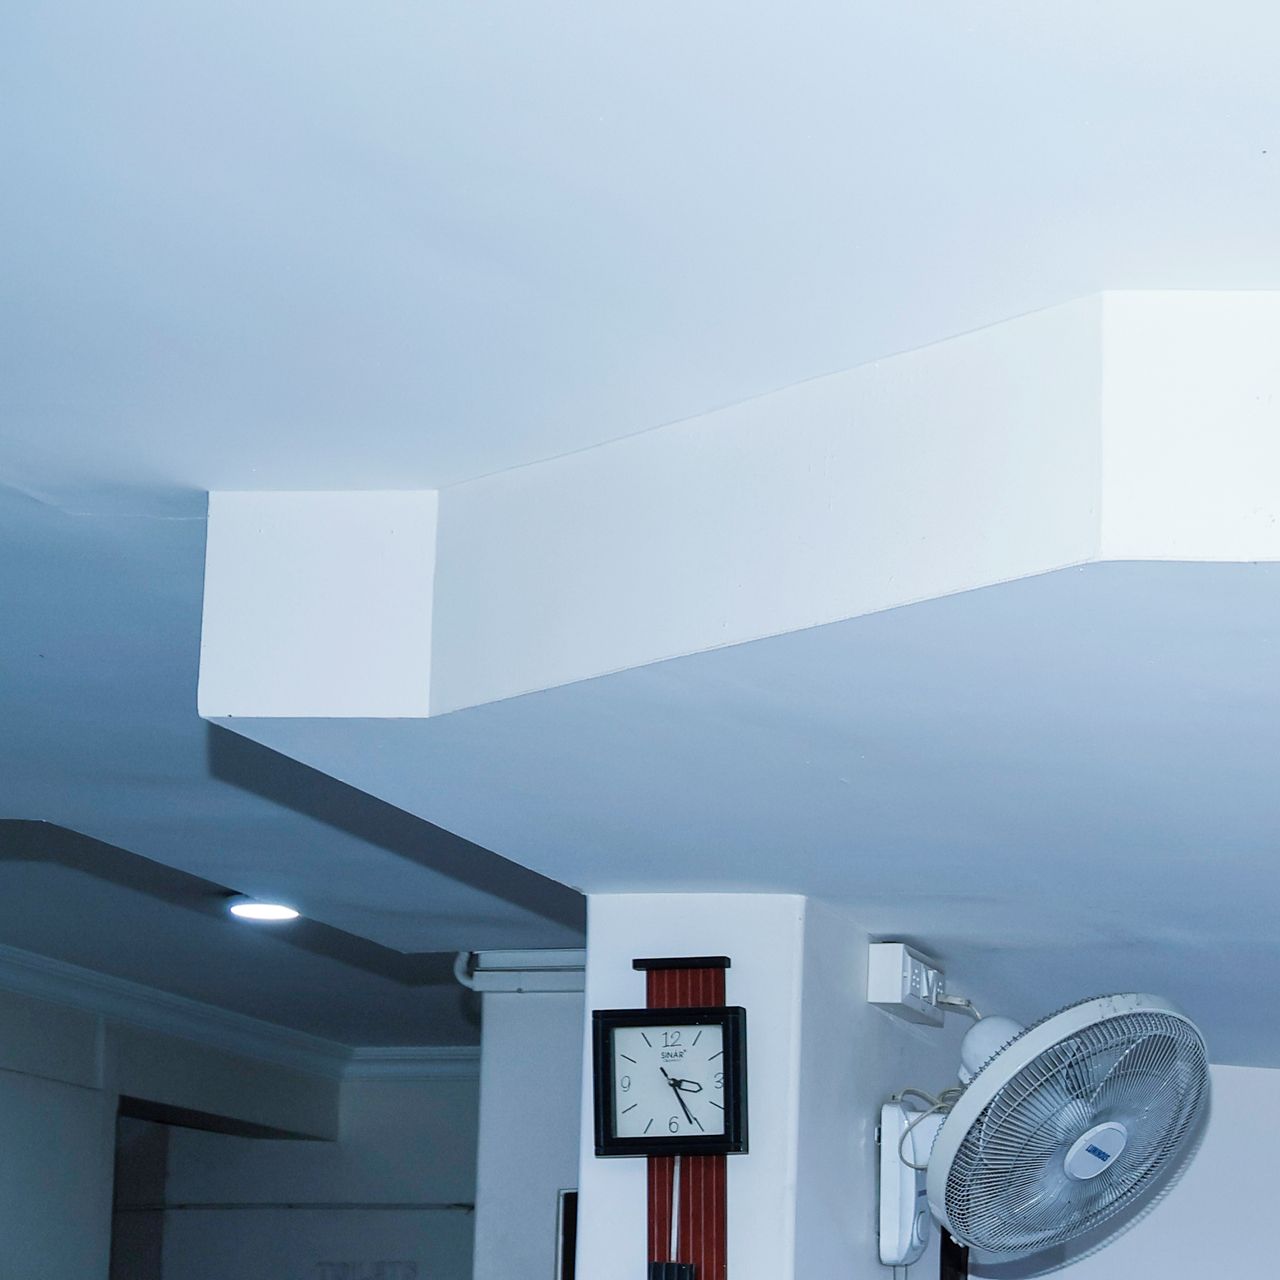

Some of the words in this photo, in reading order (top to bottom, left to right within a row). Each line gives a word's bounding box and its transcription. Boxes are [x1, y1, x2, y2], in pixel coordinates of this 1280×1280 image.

[662, 1031, 681, 1048] 12
[621, 1075, 631, 1092] 9
[714, 1072, 723, 1089] 3
[669, 1116, 678, 1133] 6
